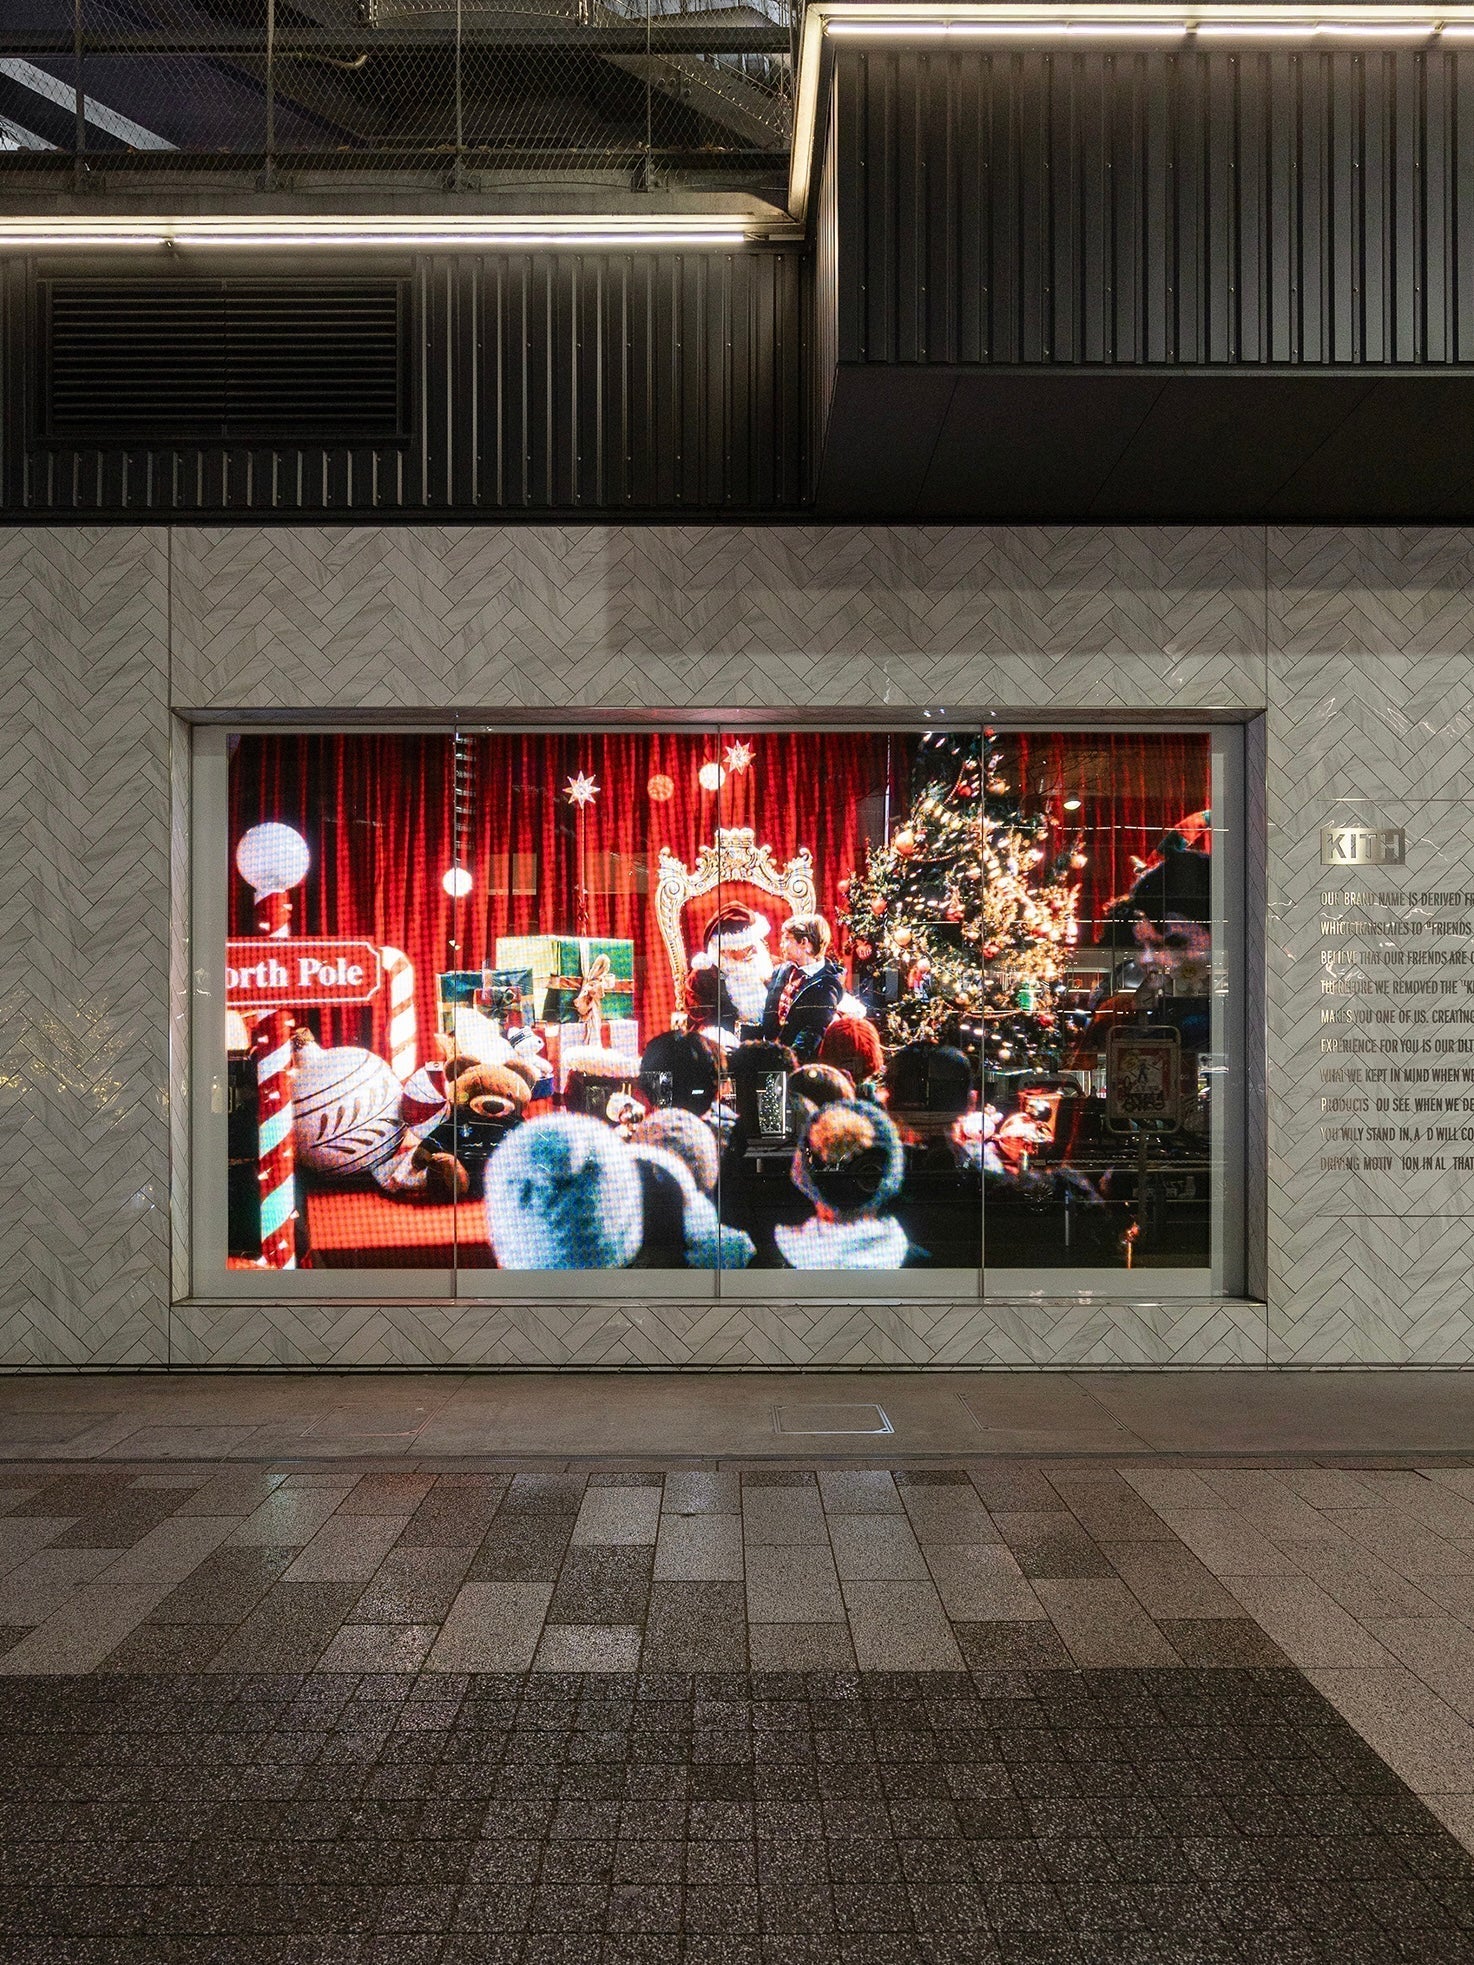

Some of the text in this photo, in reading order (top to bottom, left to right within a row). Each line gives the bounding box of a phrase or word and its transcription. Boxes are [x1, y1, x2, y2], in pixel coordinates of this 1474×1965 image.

[1326, 833, 1401, 859] KITH
[1321, 892, 1340, 906] OUR
[1344, 892, 1374, 906] BRAND
[1379, 892, 1405, 906] NAME
[1409, 892, 1418, 906] IS
[1421, 892, 1461, 906] DERIVED
[1411, 922, 1423, 936] TO
[1321, 951, 1357, 965] BELIEVE
[1359, 951, 1381, 965] THAT
[1383, 951, 1404, 965] OUR
[1407, 951, 1448, 965] FRIENDS
[1449, 951, 1467, 965] ARE
[297, 957, 363, 986] Pole
[1375, 980, 1389, 995] WE
[1392, 980, 1438, 995] REMOVED
[1440, 980, 1458, 995] THE
[1321, 1009, 1353, 1024] MAKES
[1354, 1009, 1372, 1024] YOU
[1376, 1009, 1396, 1024] ONE
[1398, 1009, 1411, 1024] OF
[1414, 1009, 1429, 1024] US.
[1321, 1039, 1377, 1053] EXPERIENCE
[1380, 1039, 1398, 1053] FOR
[1401, 1039, 1420, 1053] YOU
[1422, 1039, 1432, 1053] IS
[1435, 1039, 1454, 1053] OUR
[1320, 1068, 1344, 1082] WHAT
[1347, 1068, 1362, 1082] WE
[1365, 1068, 1388, 1082] KEPT
[1390, 1068, 1400, 1082] IN
[1403, 1068, 1430, 1082] MIND
[1432, 1068, 1459, 1082] WHEN
[1321, 1098, 1369, 1112] PRODUCTS
[1392, 1098, 1410, 1112] SEE
[1414, 1098, 1442, 1112] WHEN
[1445, 1098, 1460, 1112] WE
[1320, 1127, 1338, 1141] YOU
[1366, 1127, 1396, 1141] STAND
[1436, 1127, 1459, 1141] WILL
[1320, 1157, 1360, 1171] DRIVING
[1422, 1157, 1433, 1171] IN
